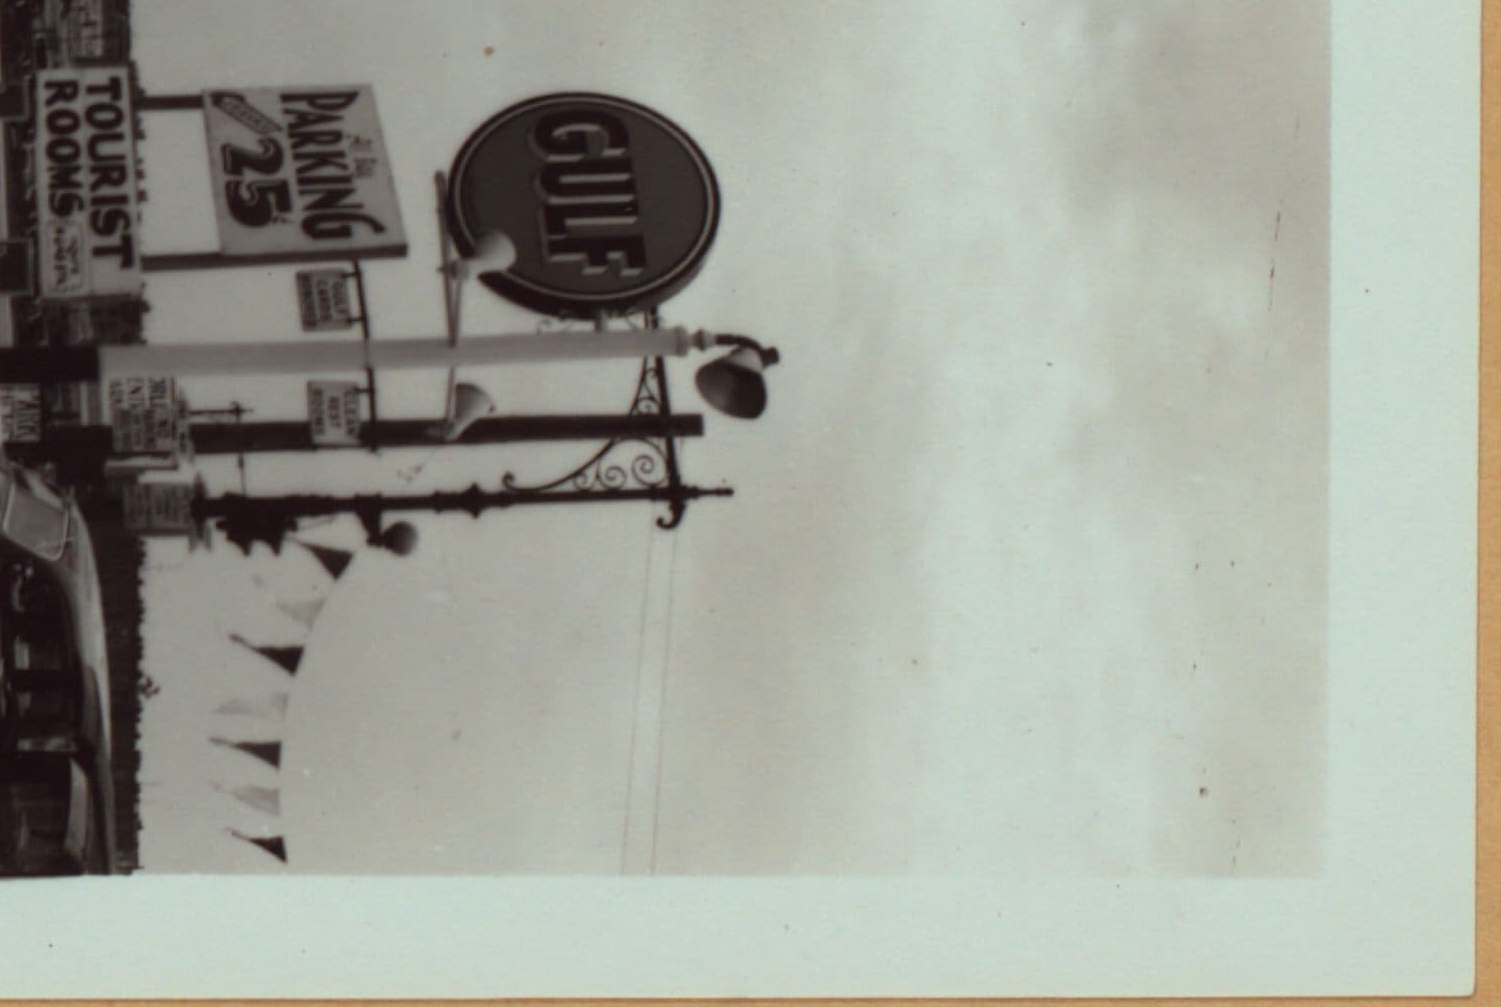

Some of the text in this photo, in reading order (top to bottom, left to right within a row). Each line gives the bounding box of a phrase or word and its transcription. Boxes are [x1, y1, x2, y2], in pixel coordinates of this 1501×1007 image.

[43, 79, 84, 219] ROOMS
[85, 76, 134, 269] TOURIST
[280, 90, 387, 240] PARKING
[531, 110, 647, 276] GULF
[328, 396, 341, 428] REST
